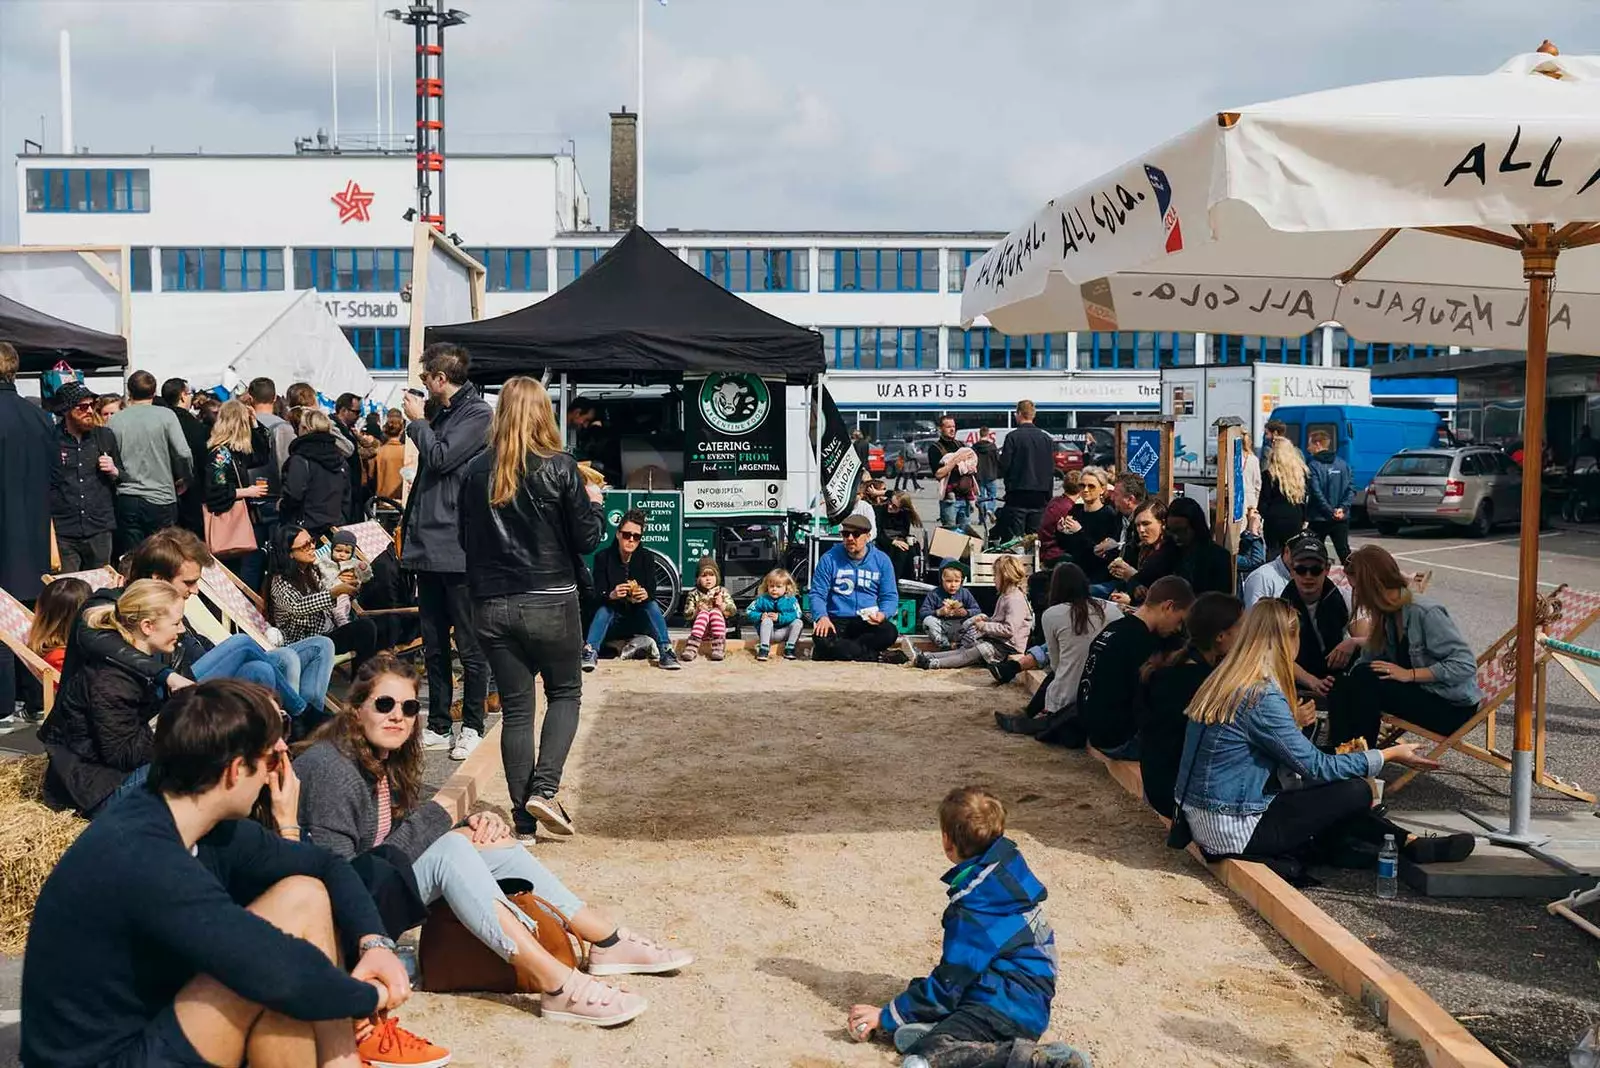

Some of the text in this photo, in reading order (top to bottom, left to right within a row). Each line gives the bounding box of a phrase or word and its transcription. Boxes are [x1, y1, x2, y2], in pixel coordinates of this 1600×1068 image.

[1444, 124, 1563, 187] ALL
[1061, 207, 1096, 260] ALL
[877, 384, 967, 398] WARPIGS
[698, 441, 751, 452] CATERING
[739, 453, 769, 461] FROM
[738, 463, 780, 471] ARGENTINA
[636, 500, 675, 508] CATERING
